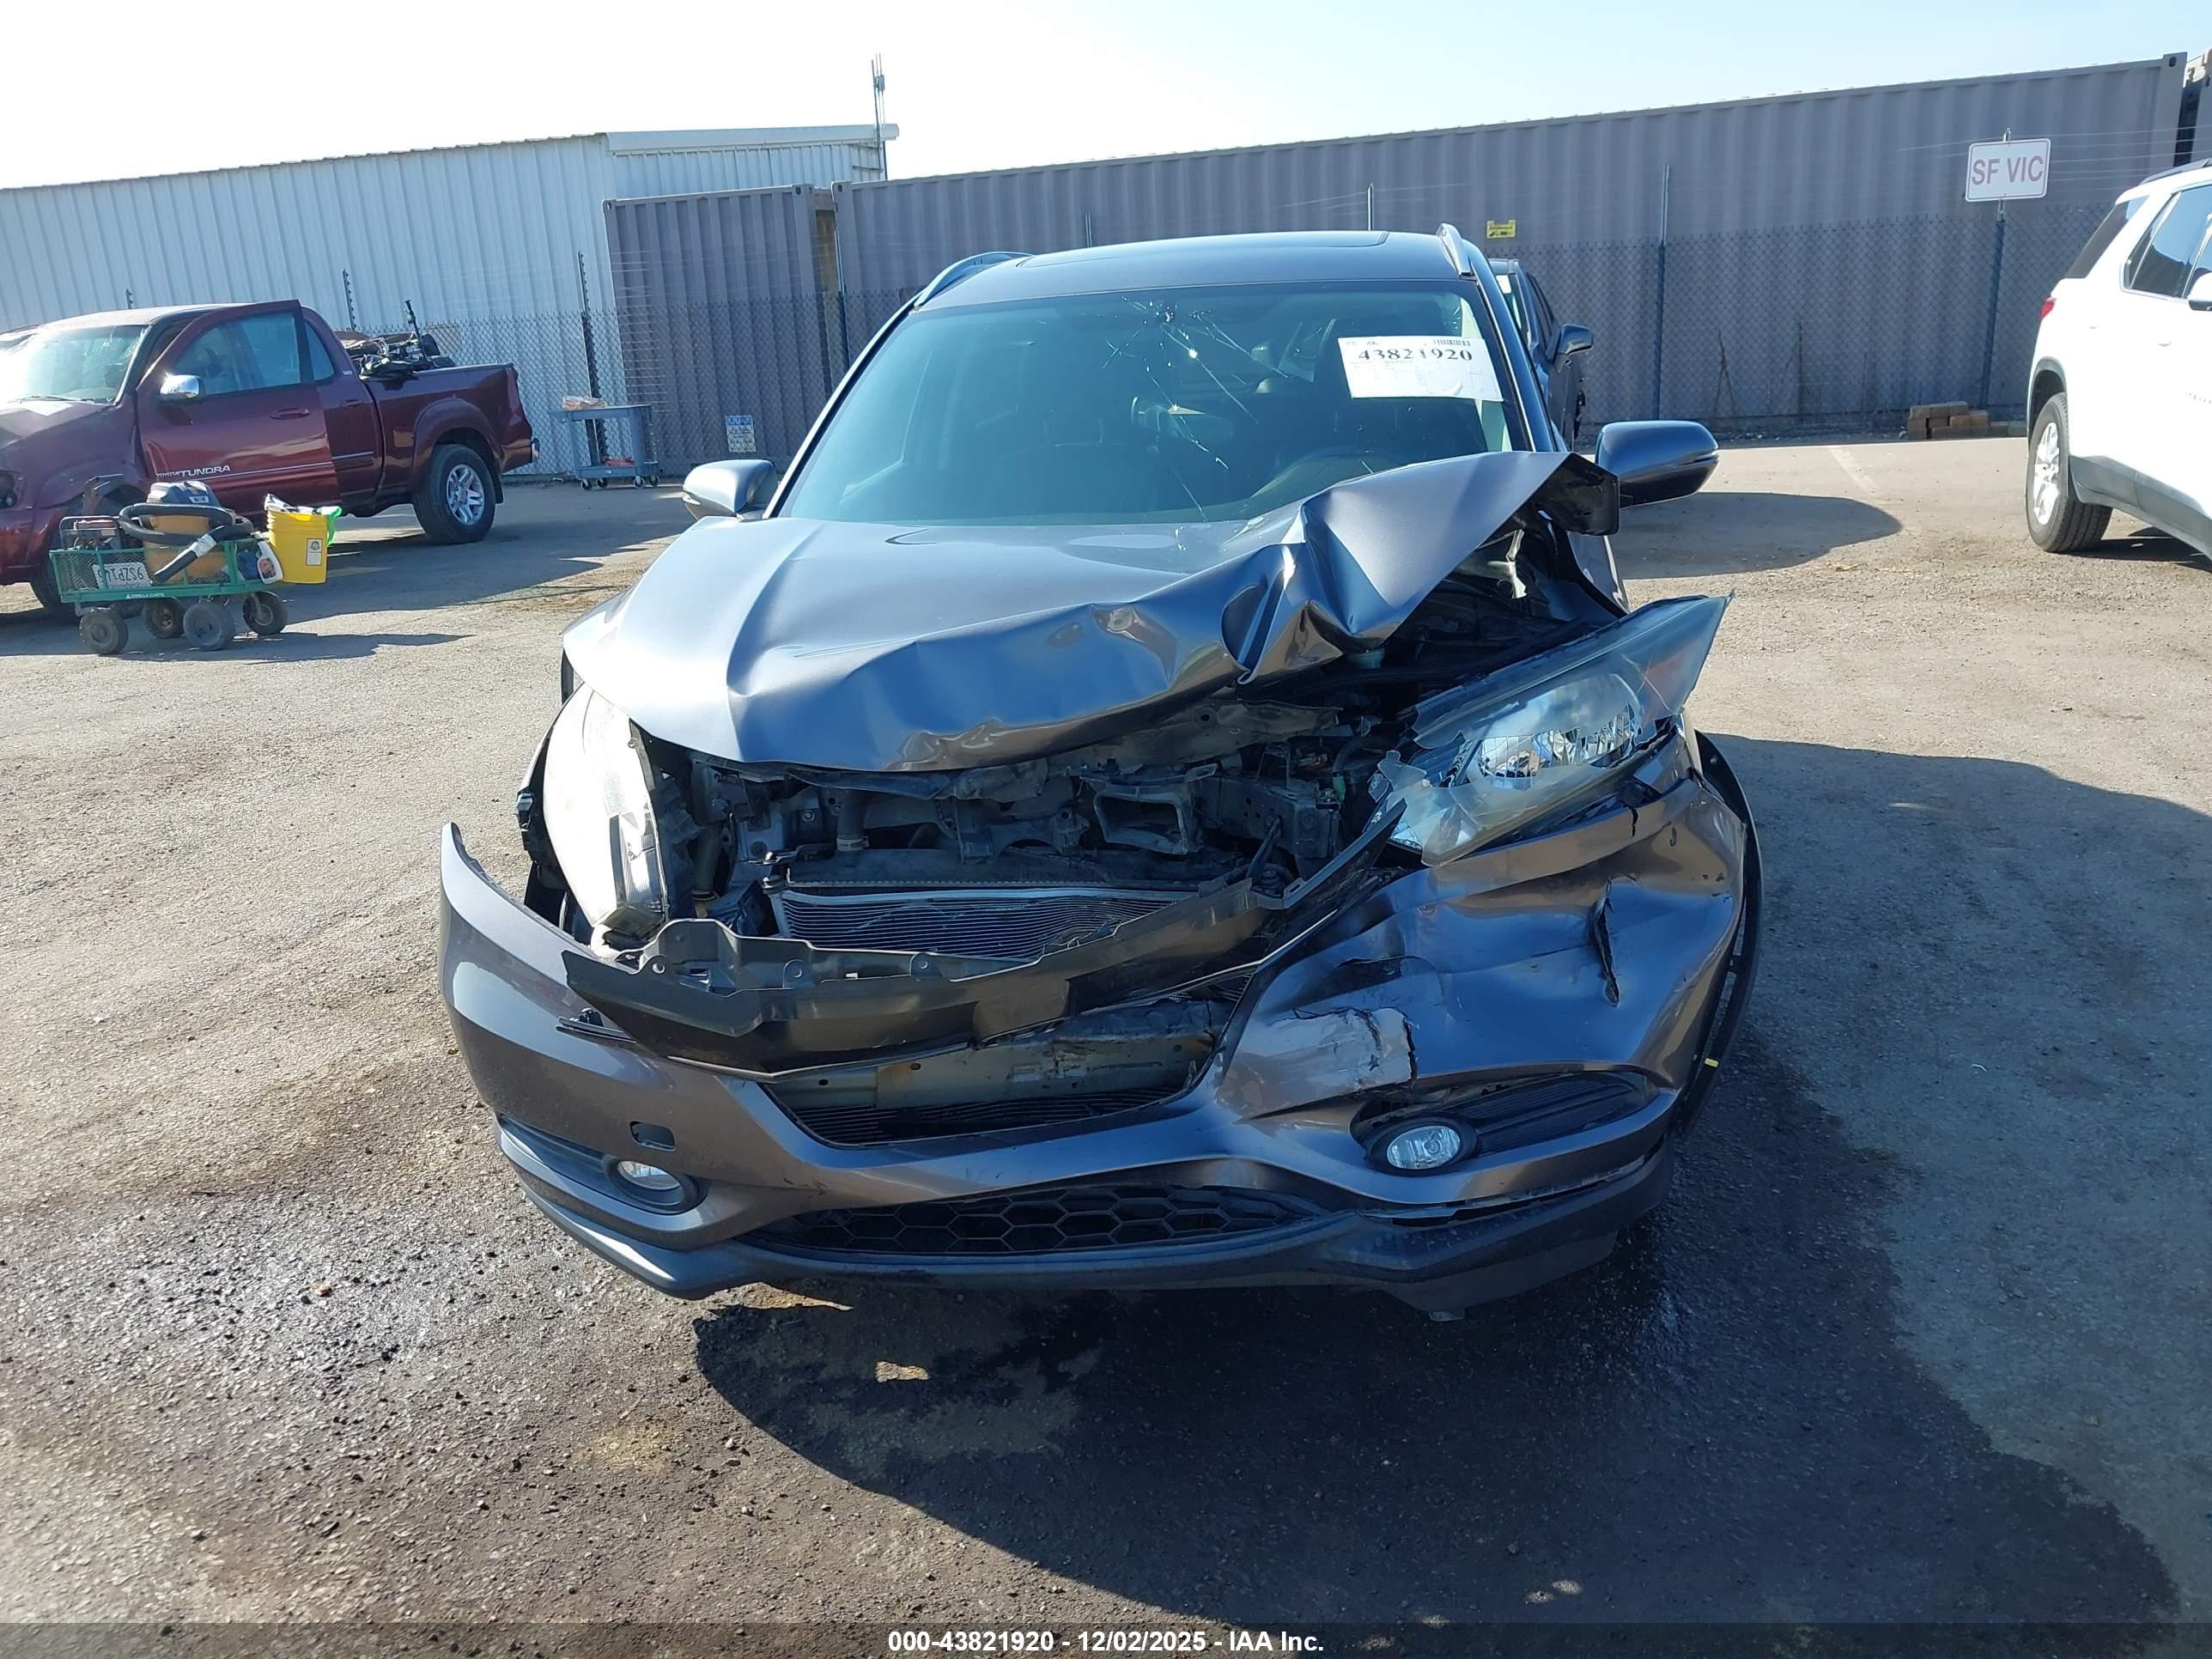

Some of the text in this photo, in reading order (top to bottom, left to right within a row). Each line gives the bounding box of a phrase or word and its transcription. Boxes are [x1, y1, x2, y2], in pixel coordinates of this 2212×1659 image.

[1972, 155, 2044, 185] SF VIC
[1358, 348, 1474, 362] 43821920
[179, 465, 231, 477] TUNDRA
